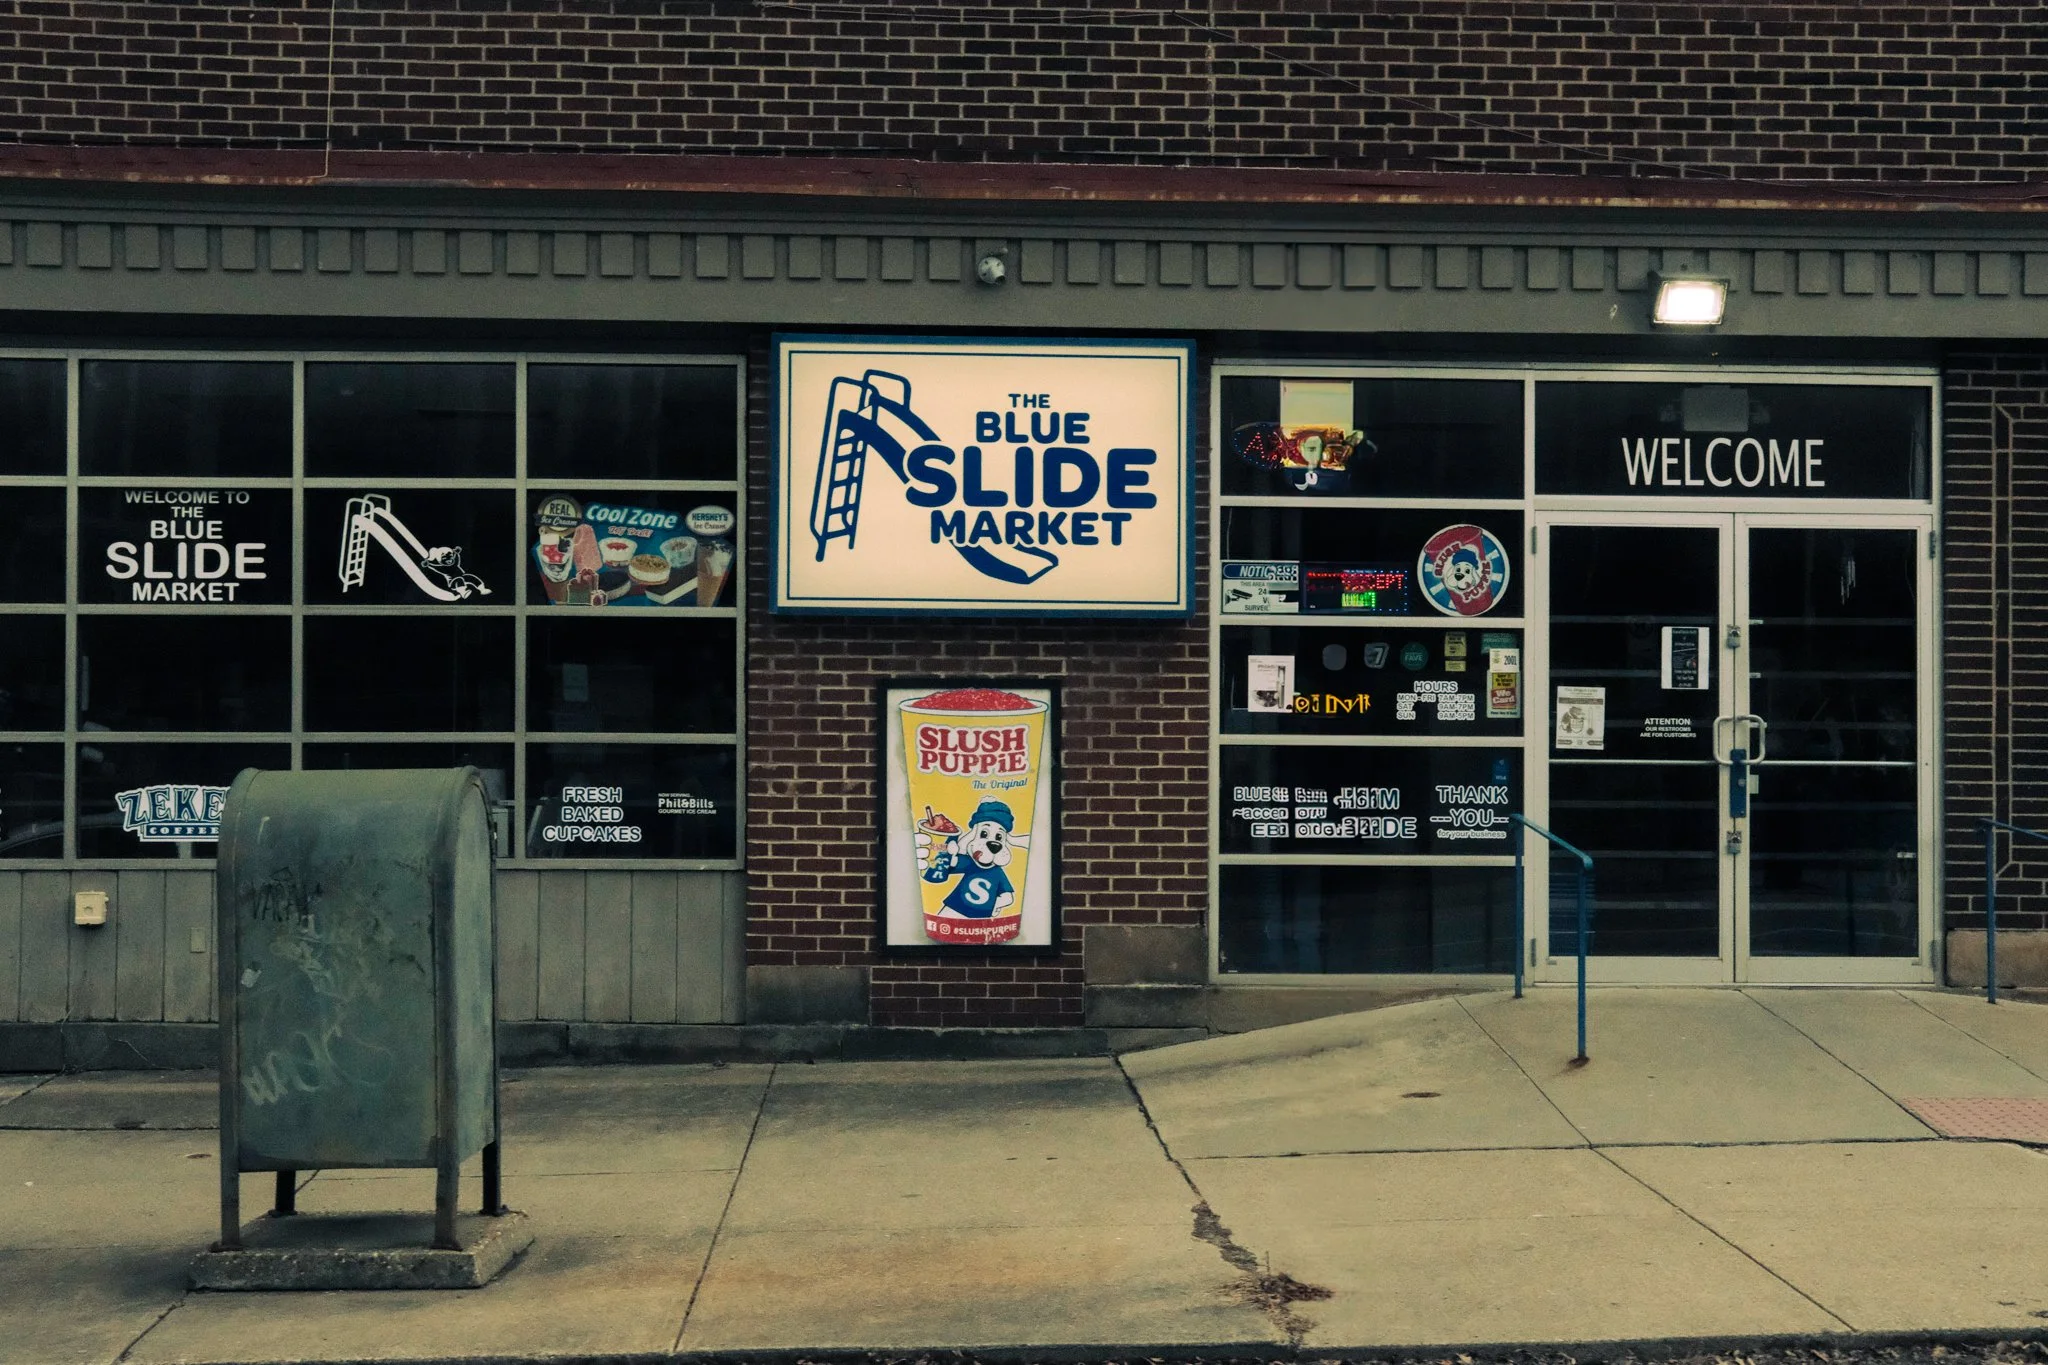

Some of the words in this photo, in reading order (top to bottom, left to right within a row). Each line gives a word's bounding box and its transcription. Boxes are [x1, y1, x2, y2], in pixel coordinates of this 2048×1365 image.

[1008, 393, 1050, 408] THE
[976, 411, 1090, 444] BLUE
[1621, 437, 1826, 488] WELCOME
[905, 444, 1158, 509] SLIDE
[125, 490, 220, 504] WELCOME
[225, 490, 250, 504] TO
[171, 506, 204, 518] THE
[549, 502, 571, 516] REAL
[586, 504, 625, 524] Cool
[627, 508, 678, 529] Zone
[150, 520, 223, 539] BLUE
[930, 509, 1132, 546] MARKET
[106, 541, 267, 580] SLIDE
[132, 582, 240, 602] MARKET
[1414, 681, 1458, 693] HOURS
[1397, 693, 1417, 702] MON
[1421, 694, 1436, 703] FRI
[1397, 702, 1415, 711] SAT
[1397, 711, 1416, 720] SUN
[1644, 717, 1691, 726] ATTENTION
[919, 726, 1026, 753] SLUSH
[972, 779, 987, 790] The
[990, 778, 1027, 791] Original
[562, 786, 623, 803] FRESH
[1435, 785, 1509, 804] THANK
[658, 798, 714, 809] Phil&Bills
[561, 805, 624, 822] BAKED
[542, 825, 642, 842] CUPCAKES
[1437, 828, 1449, 839] for
[1450, 830, 1470, 840] your
[1470, 828, 1507, 839] business
[965, 877, 992, 905] S
